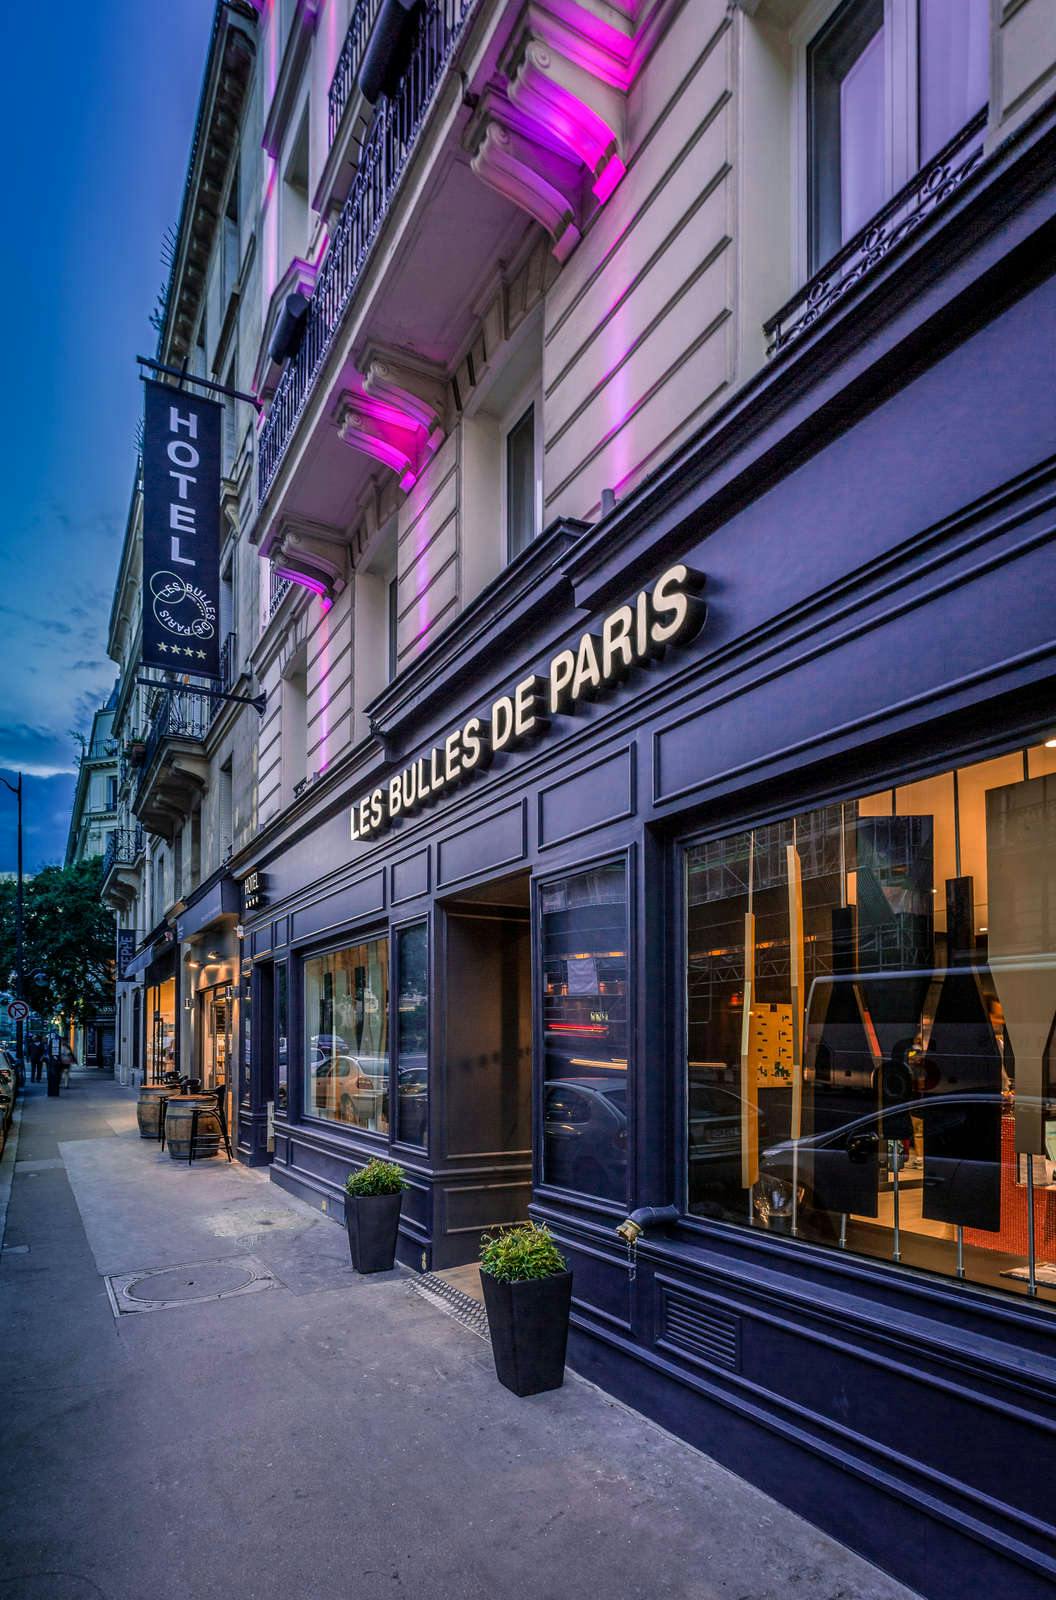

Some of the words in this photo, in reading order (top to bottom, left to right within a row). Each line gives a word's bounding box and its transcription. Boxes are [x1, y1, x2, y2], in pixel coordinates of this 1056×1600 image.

[167, 406, 200, 567] HOTEL
[159, 582, 181, 598] LES
[186, 583, 216, 621] BULLES
[159, 610, 191, 635] PARIS
[194, 621, 211, 635] DE
[350, 788, 382, 841] LES
[389, 717, 482, 818] BULLES
[491, 674, 537, 752] DE
[550, 563, 690, 714] PARIS
[244, 871, 259, 896] HOTEL
